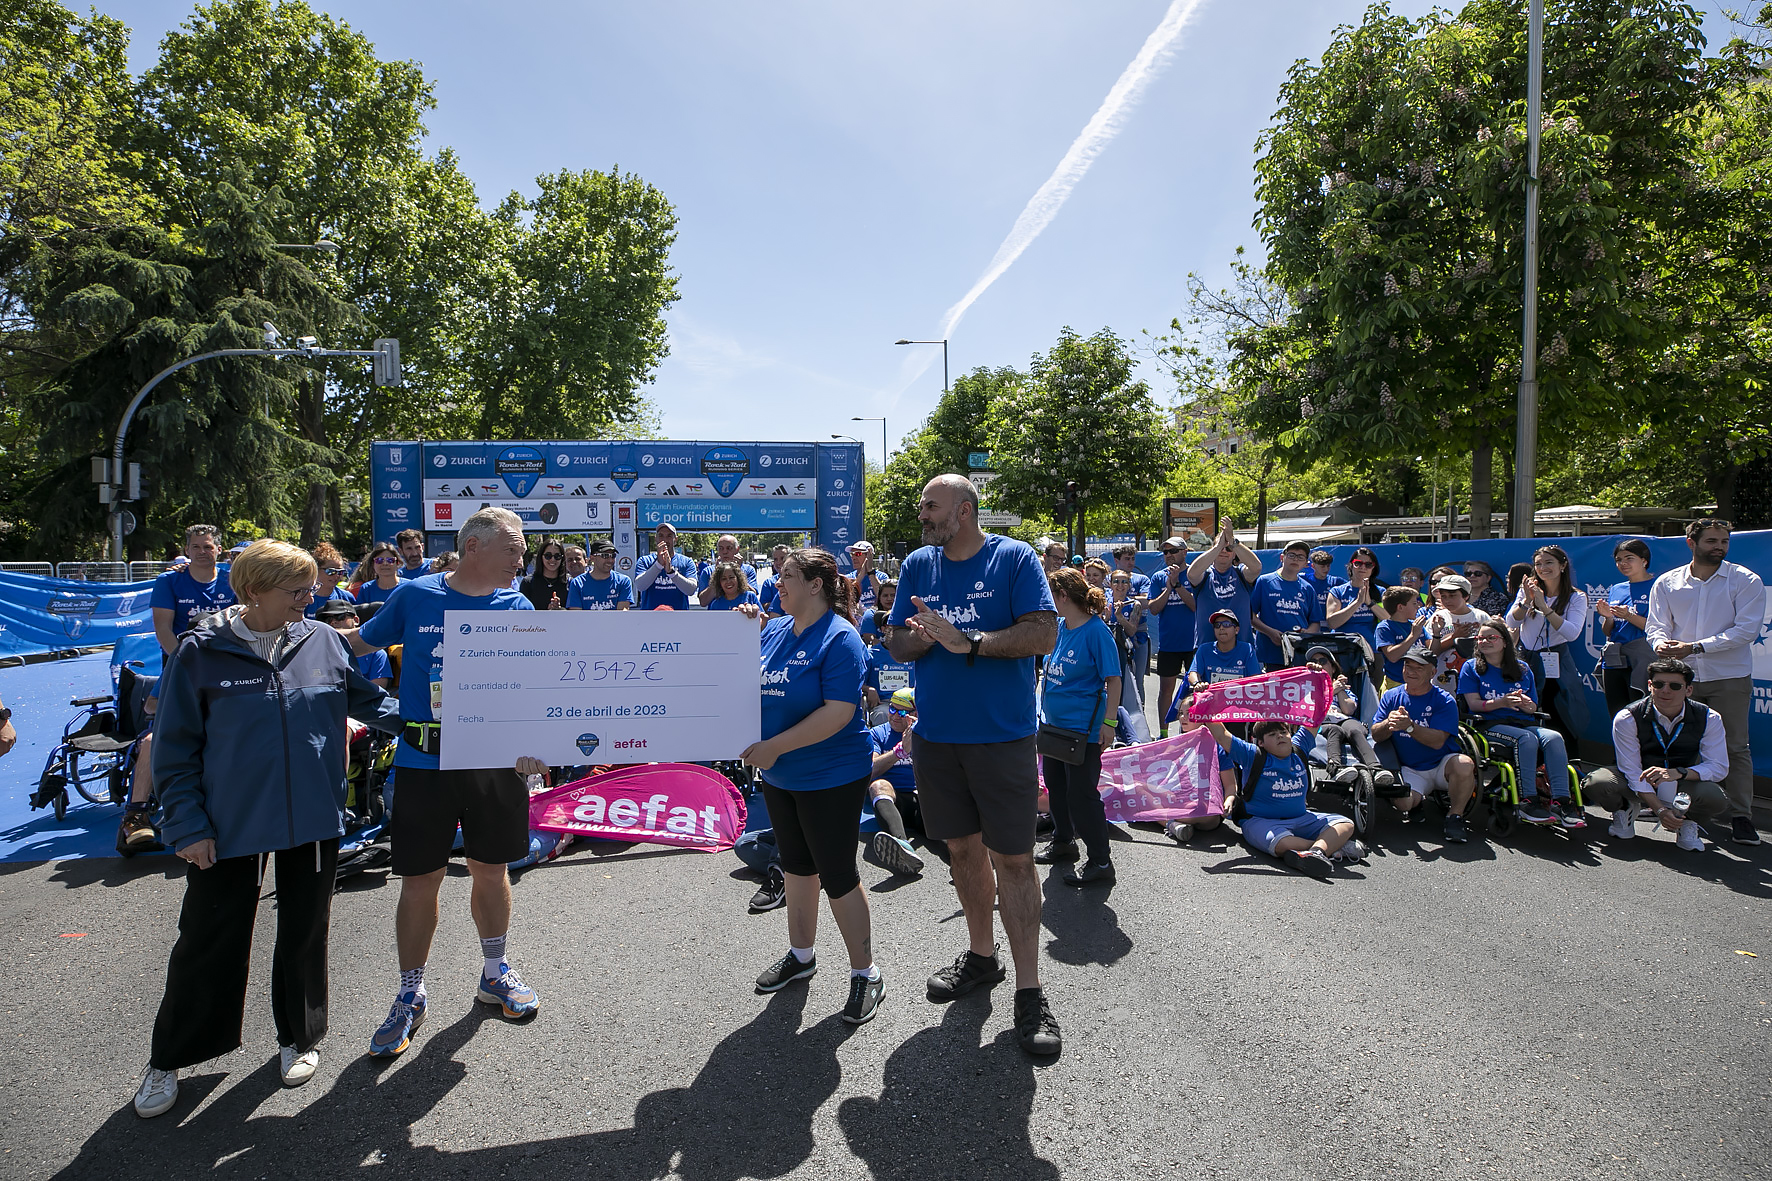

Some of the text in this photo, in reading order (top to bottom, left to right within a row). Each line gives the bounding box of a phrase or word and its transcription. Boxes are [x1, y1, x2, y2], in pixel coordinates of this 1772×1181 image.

[450, 457, 486, 465] ZURICH
[573, 456, 608, 464] ZURICH
[658, 457, 692, 465] ZURICH
[775, 457, 808, 465] ZURICH
[645, 512, 732, 525] 1€ por finisher
[967, 591, 993, 599] ZURICH
[512, 625, 547, 633] Foundation
[497, 649, 546, 657] Foundation
[548, 649, 569, 657] dona
[640, 642, 681, 653] AEFAT
[234, 678, 263, 686] ZURICH
[471, 682, 508, 690] cantidad
[1224, 676, 1316, 704] aefat
[458, 704, 666, 723] Fecha 23 de abril de 2023
[614, 739, 648, 749] aefat
[573, 794, 721, 840] aefat
